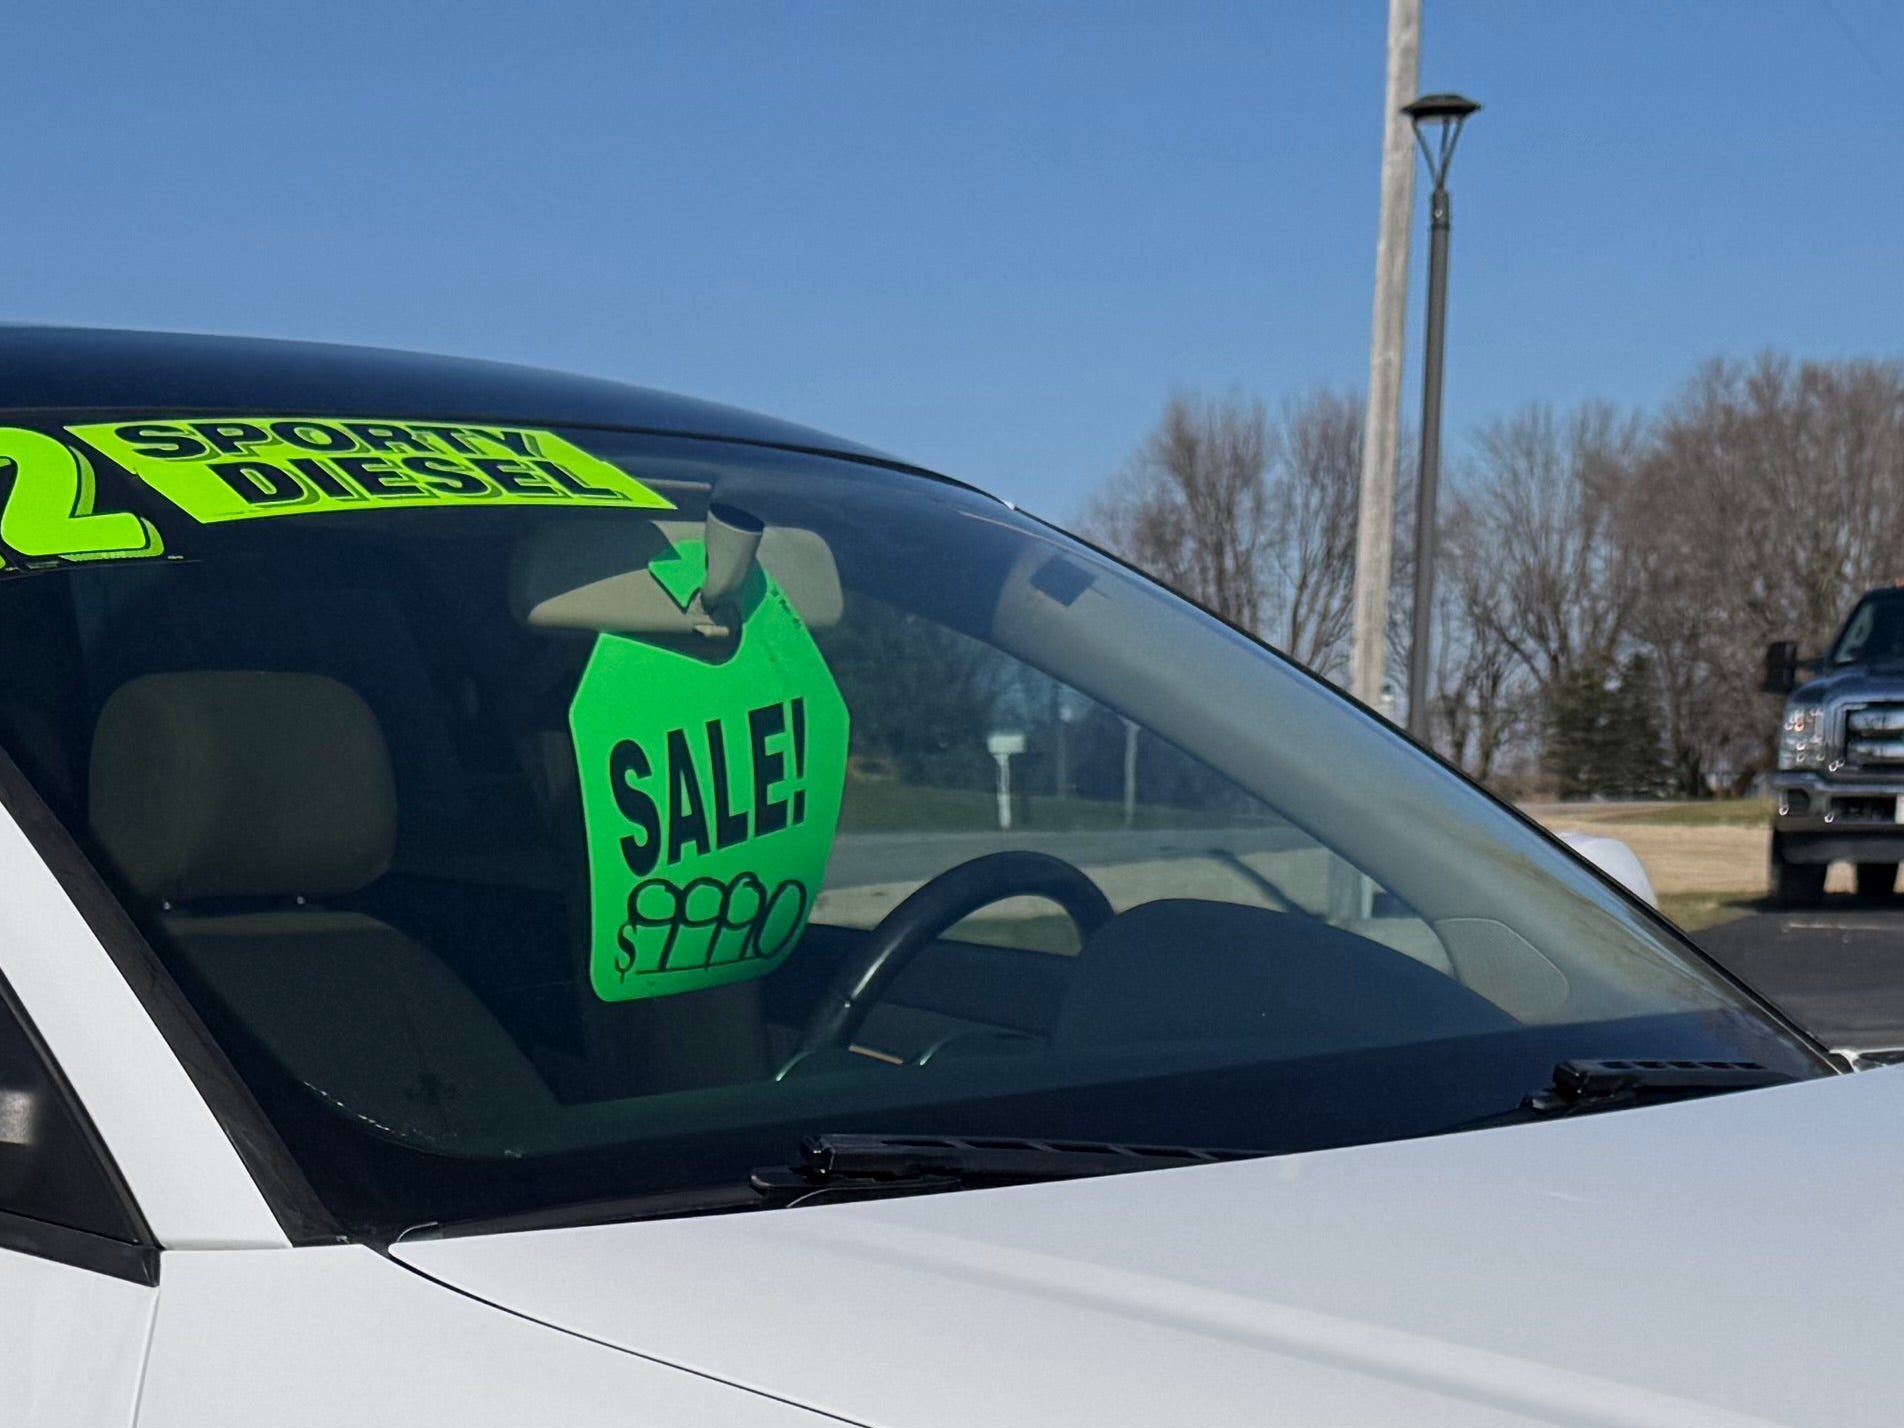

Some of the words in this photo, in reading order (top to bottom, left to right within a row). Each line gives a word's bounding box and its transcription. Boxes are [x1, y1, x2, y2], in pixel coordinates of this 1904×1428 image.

[113, 421, 546, 462] SPORTY
[208, 456, 626, 506] DIESEL
[608, 697, 806, 878] SALE!
[614, 871, 809, 985] $9990
